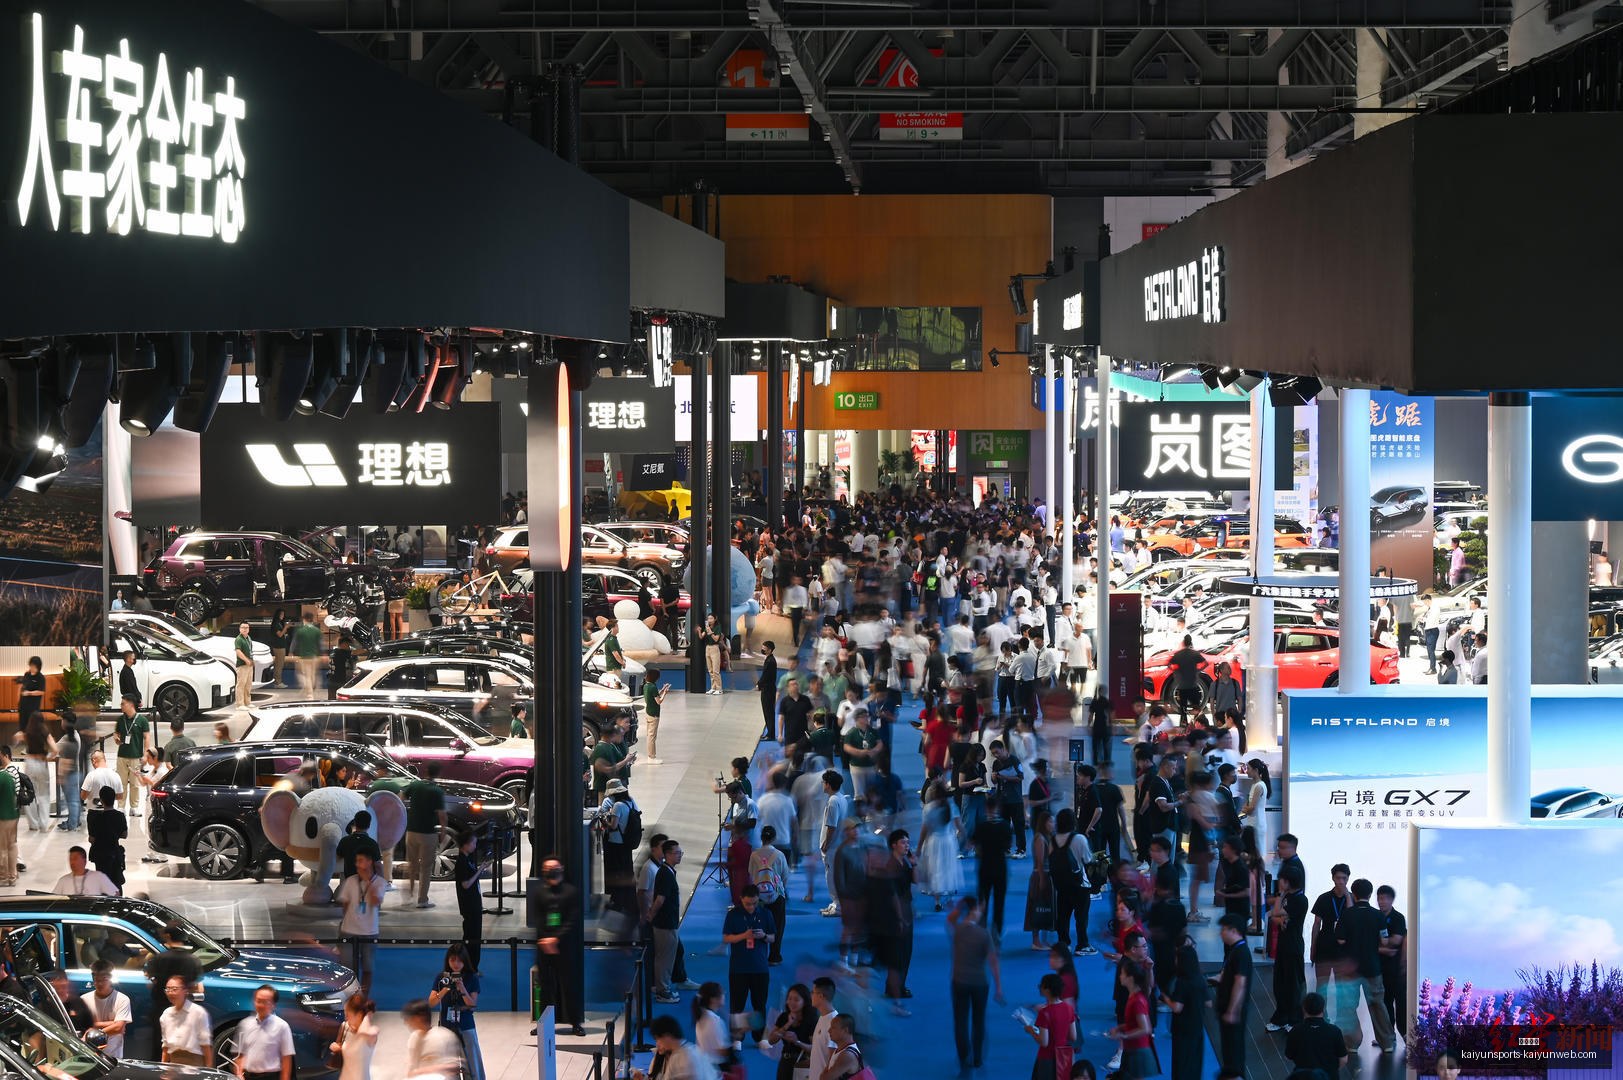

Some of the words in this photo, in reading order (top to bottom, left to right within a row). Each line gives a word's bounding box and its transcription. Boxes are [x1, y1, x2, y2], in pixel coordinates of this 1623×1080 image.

[18, 12, 246, 243] 人车家全生态
[761, 129, 774, 139] 11
[920, 129, 928, 138] 9
[838, 394, 856, 408] 10
[859, 394, 874, 403] 出口
[588, 401, 646, 429] 理想
[1144, 412, 1251, 479] 岚图
[358, 441, 452, 486] 理想
[1311, 718, 1418, 726] AISTALAND
[1425, 717, 1451, 727] 启境
[1328, 789, 1376, 805] 启境
[1383, 789, 1471, 806] GX7
